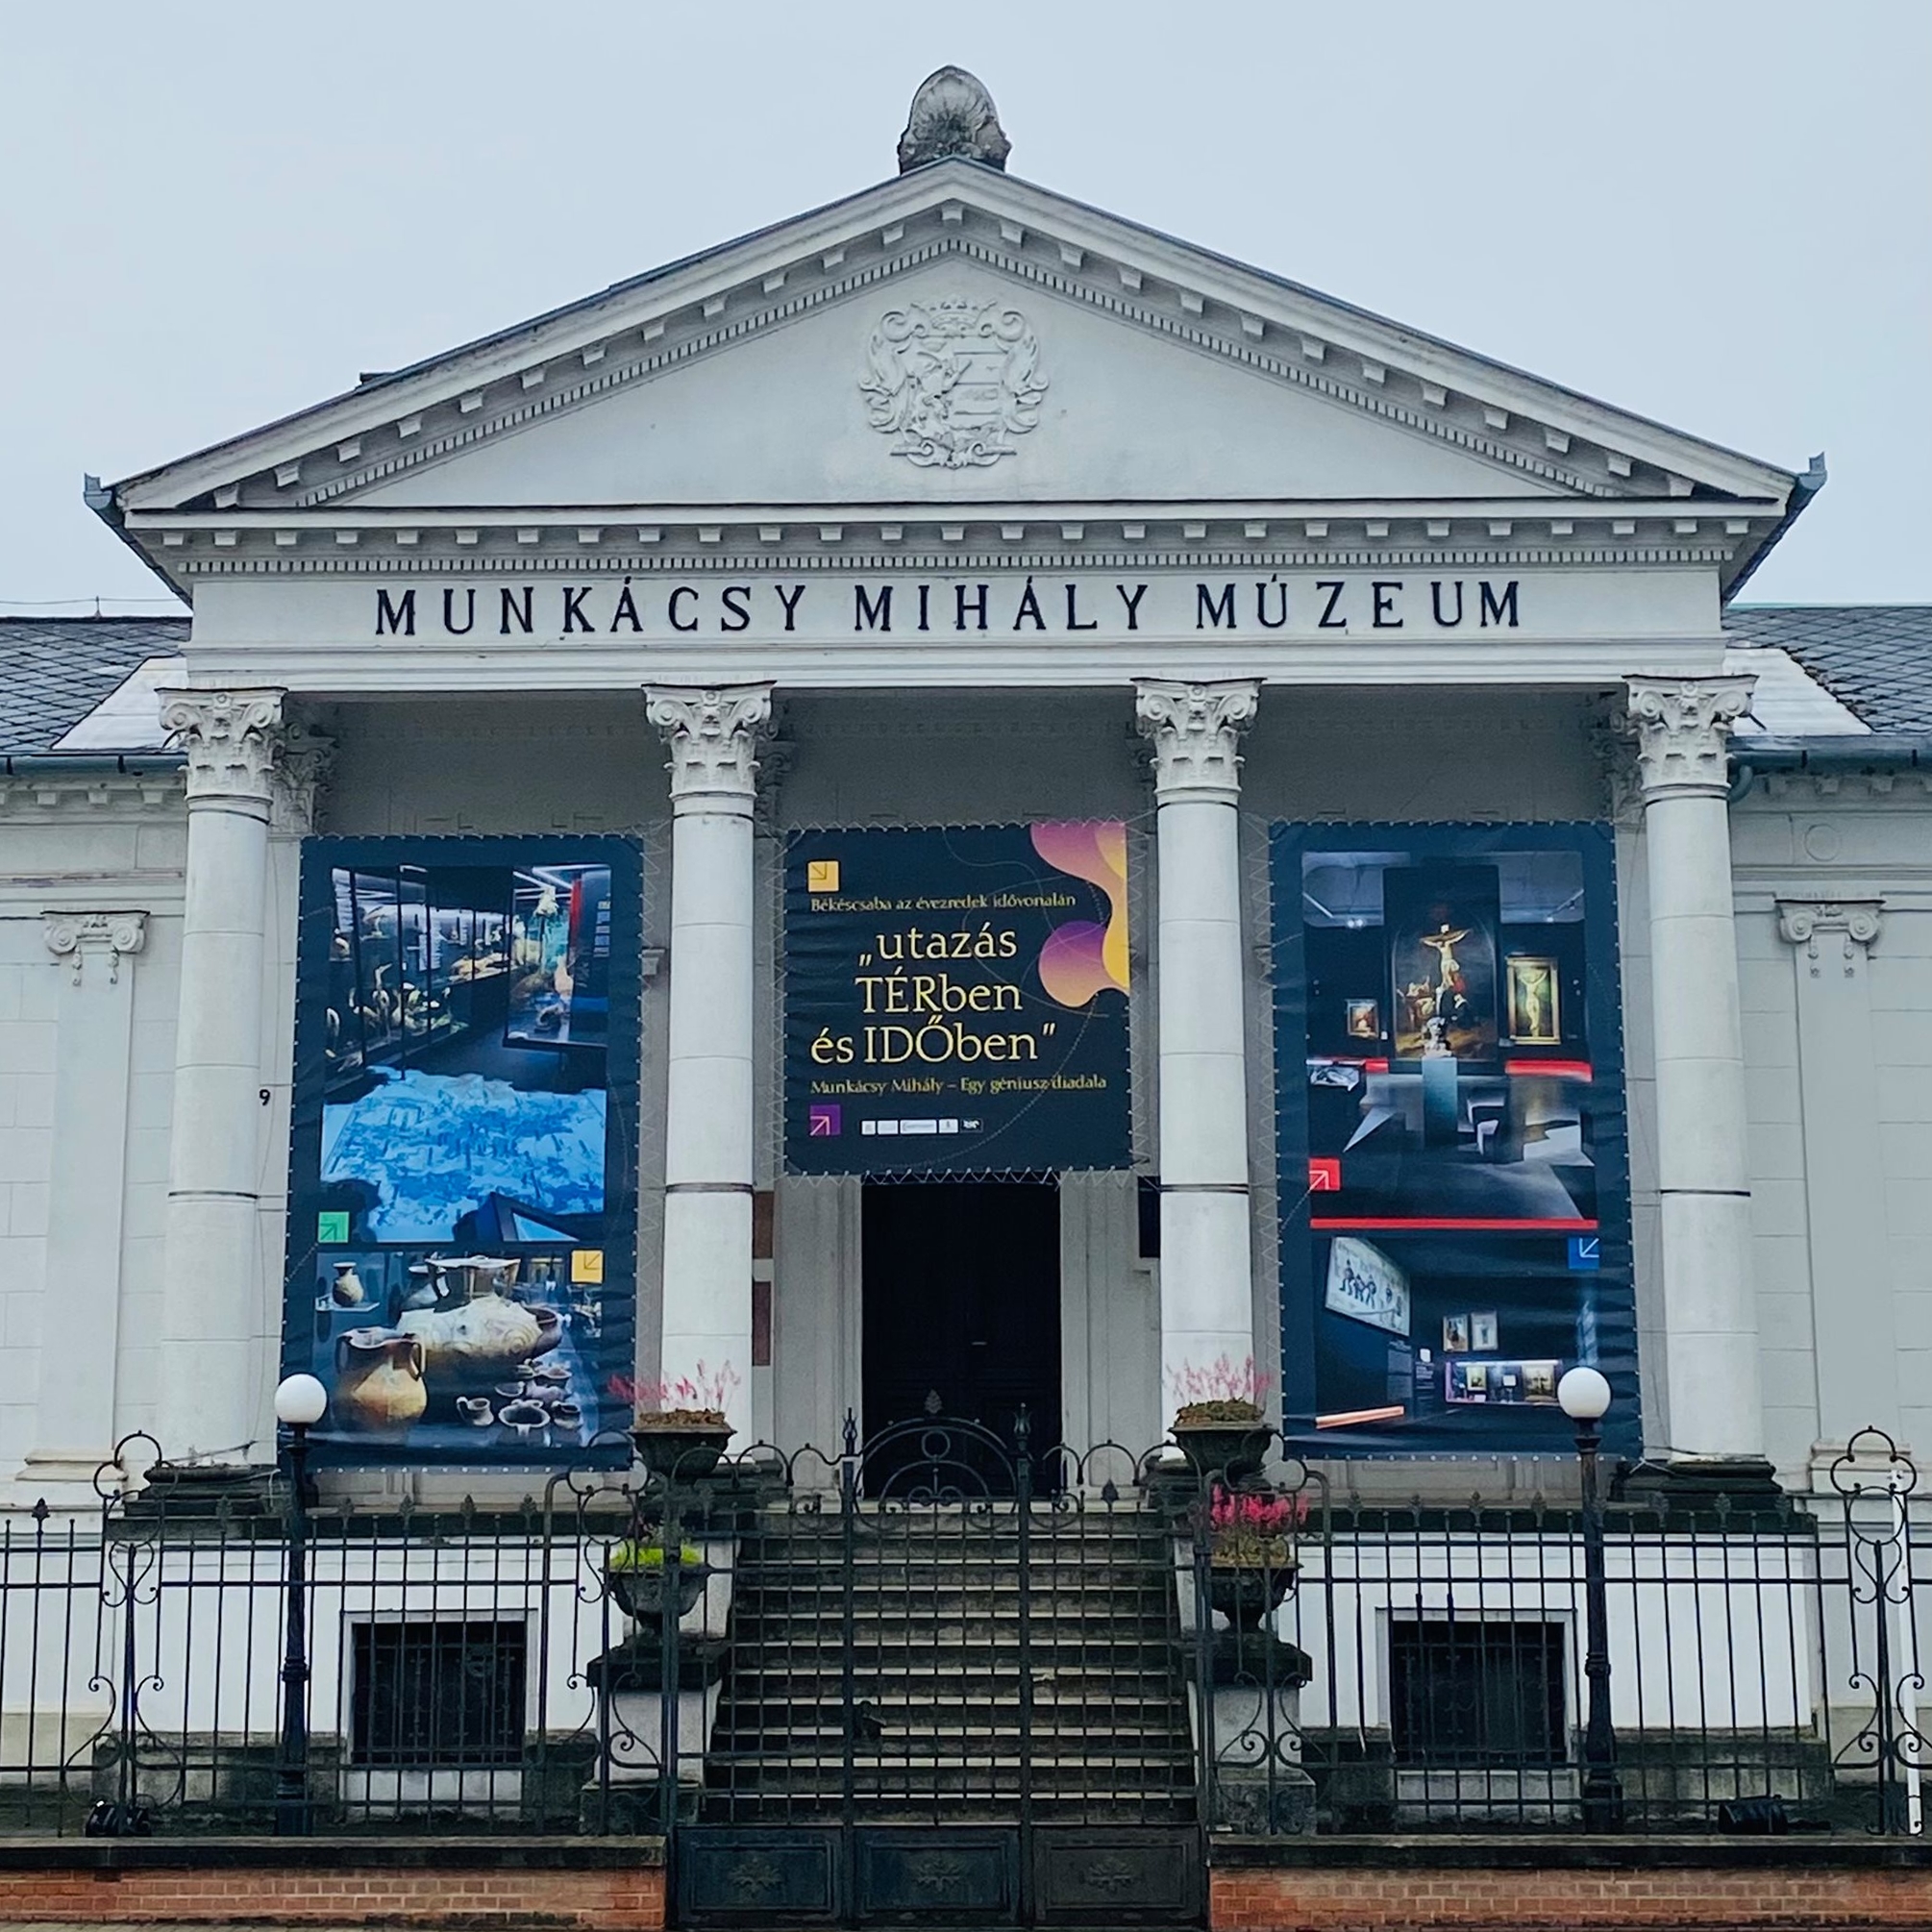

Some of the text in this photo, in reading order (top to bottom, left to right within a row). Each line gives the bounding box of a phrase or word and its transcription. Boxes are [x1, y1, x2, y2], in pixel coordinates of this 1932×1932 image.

[375, 573, 1519, 636] MUNKÁCSY MIHÁLY MÚZEUM
[810, 896, 892, 911] Békéscsaba
[896, 900, 912, 910] az
[915, 895, 988, 910] évezredek
[855, 965, 1024, 1014] TÉRben
[810, 1027, 855, 1064] és
[810, 1078, 886, 1096] Munkácsy
[891, 1077, 943, 1094] Mihály
[960, 1077, 984, 1094] Egy
[1051, 1074, 1107, 1090] diadala
